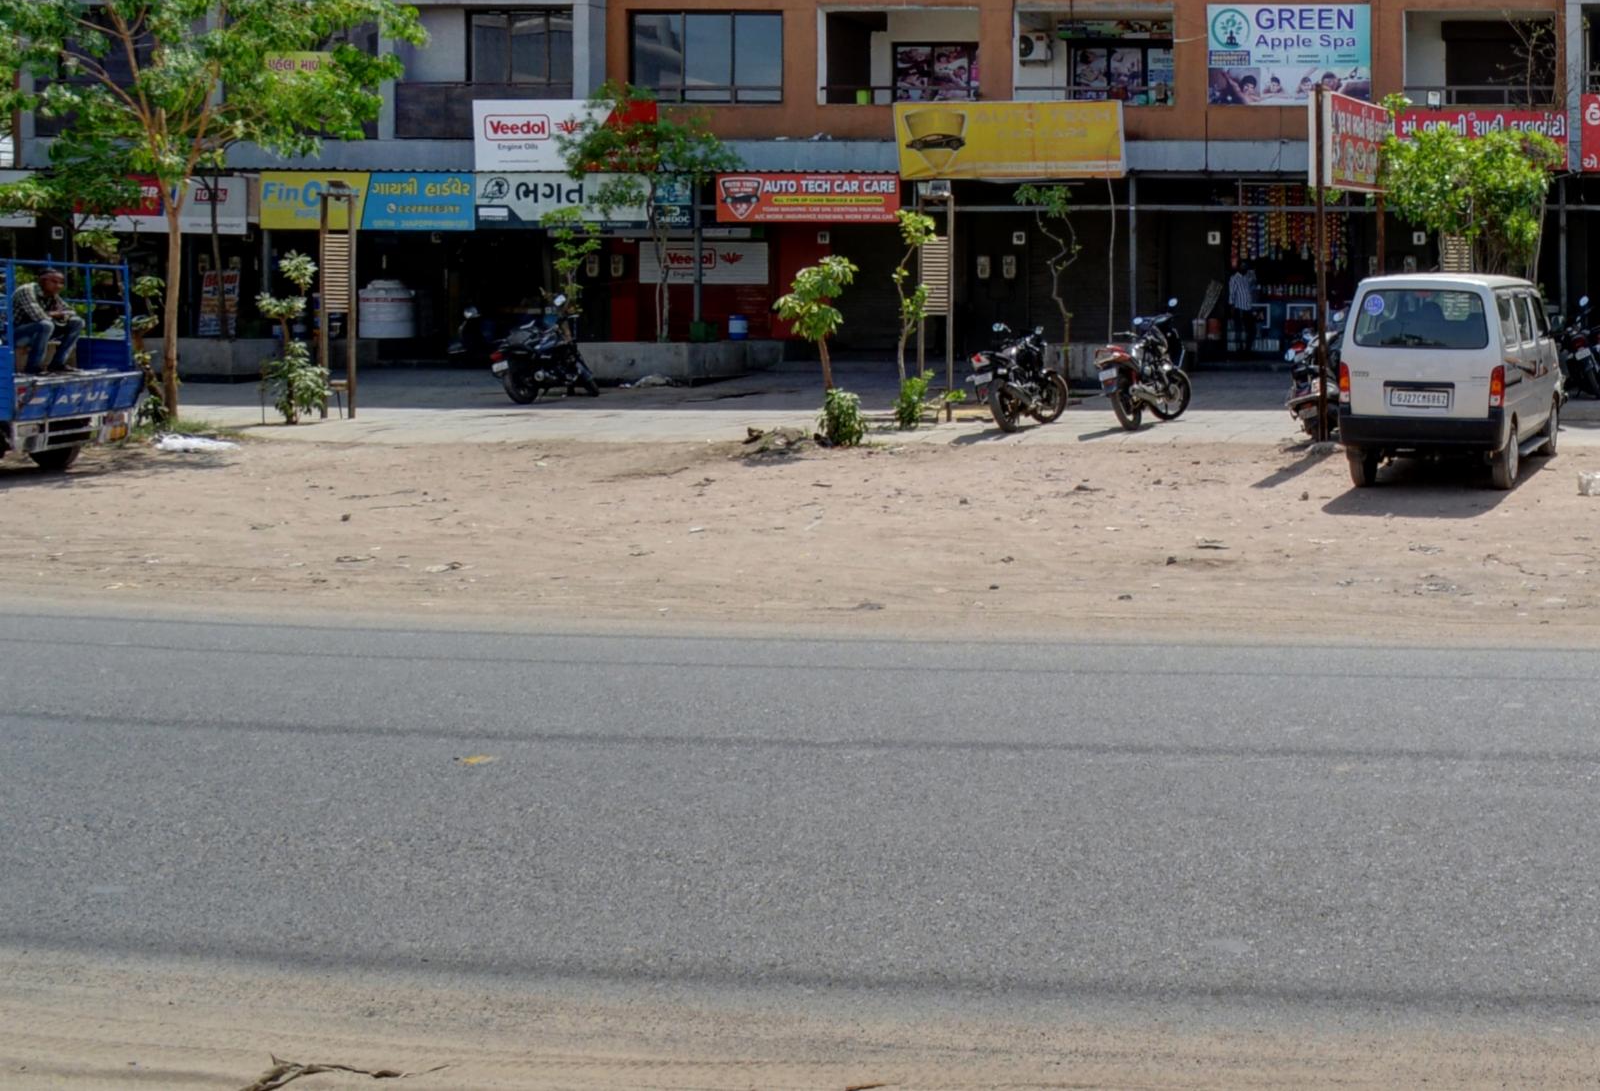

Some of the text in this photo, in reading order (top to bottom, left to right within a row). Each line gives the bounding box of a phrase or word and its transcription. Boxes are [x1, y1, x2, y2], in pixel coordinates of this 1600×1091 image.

[1255, 7, 1354, 30] GREEN
[1255, 34, 1356, 51] Apple Spa
[489, 120, 546, 135] Veedol
[498, 143, 522, 151] Engine
[515, 182, 584, 204] ભગત
[763, 180, 896, 193] AUTO TECH CAR CARE
[667, 253, 713, 265] Veeol
[56, 391, 109, 405] ATUL
